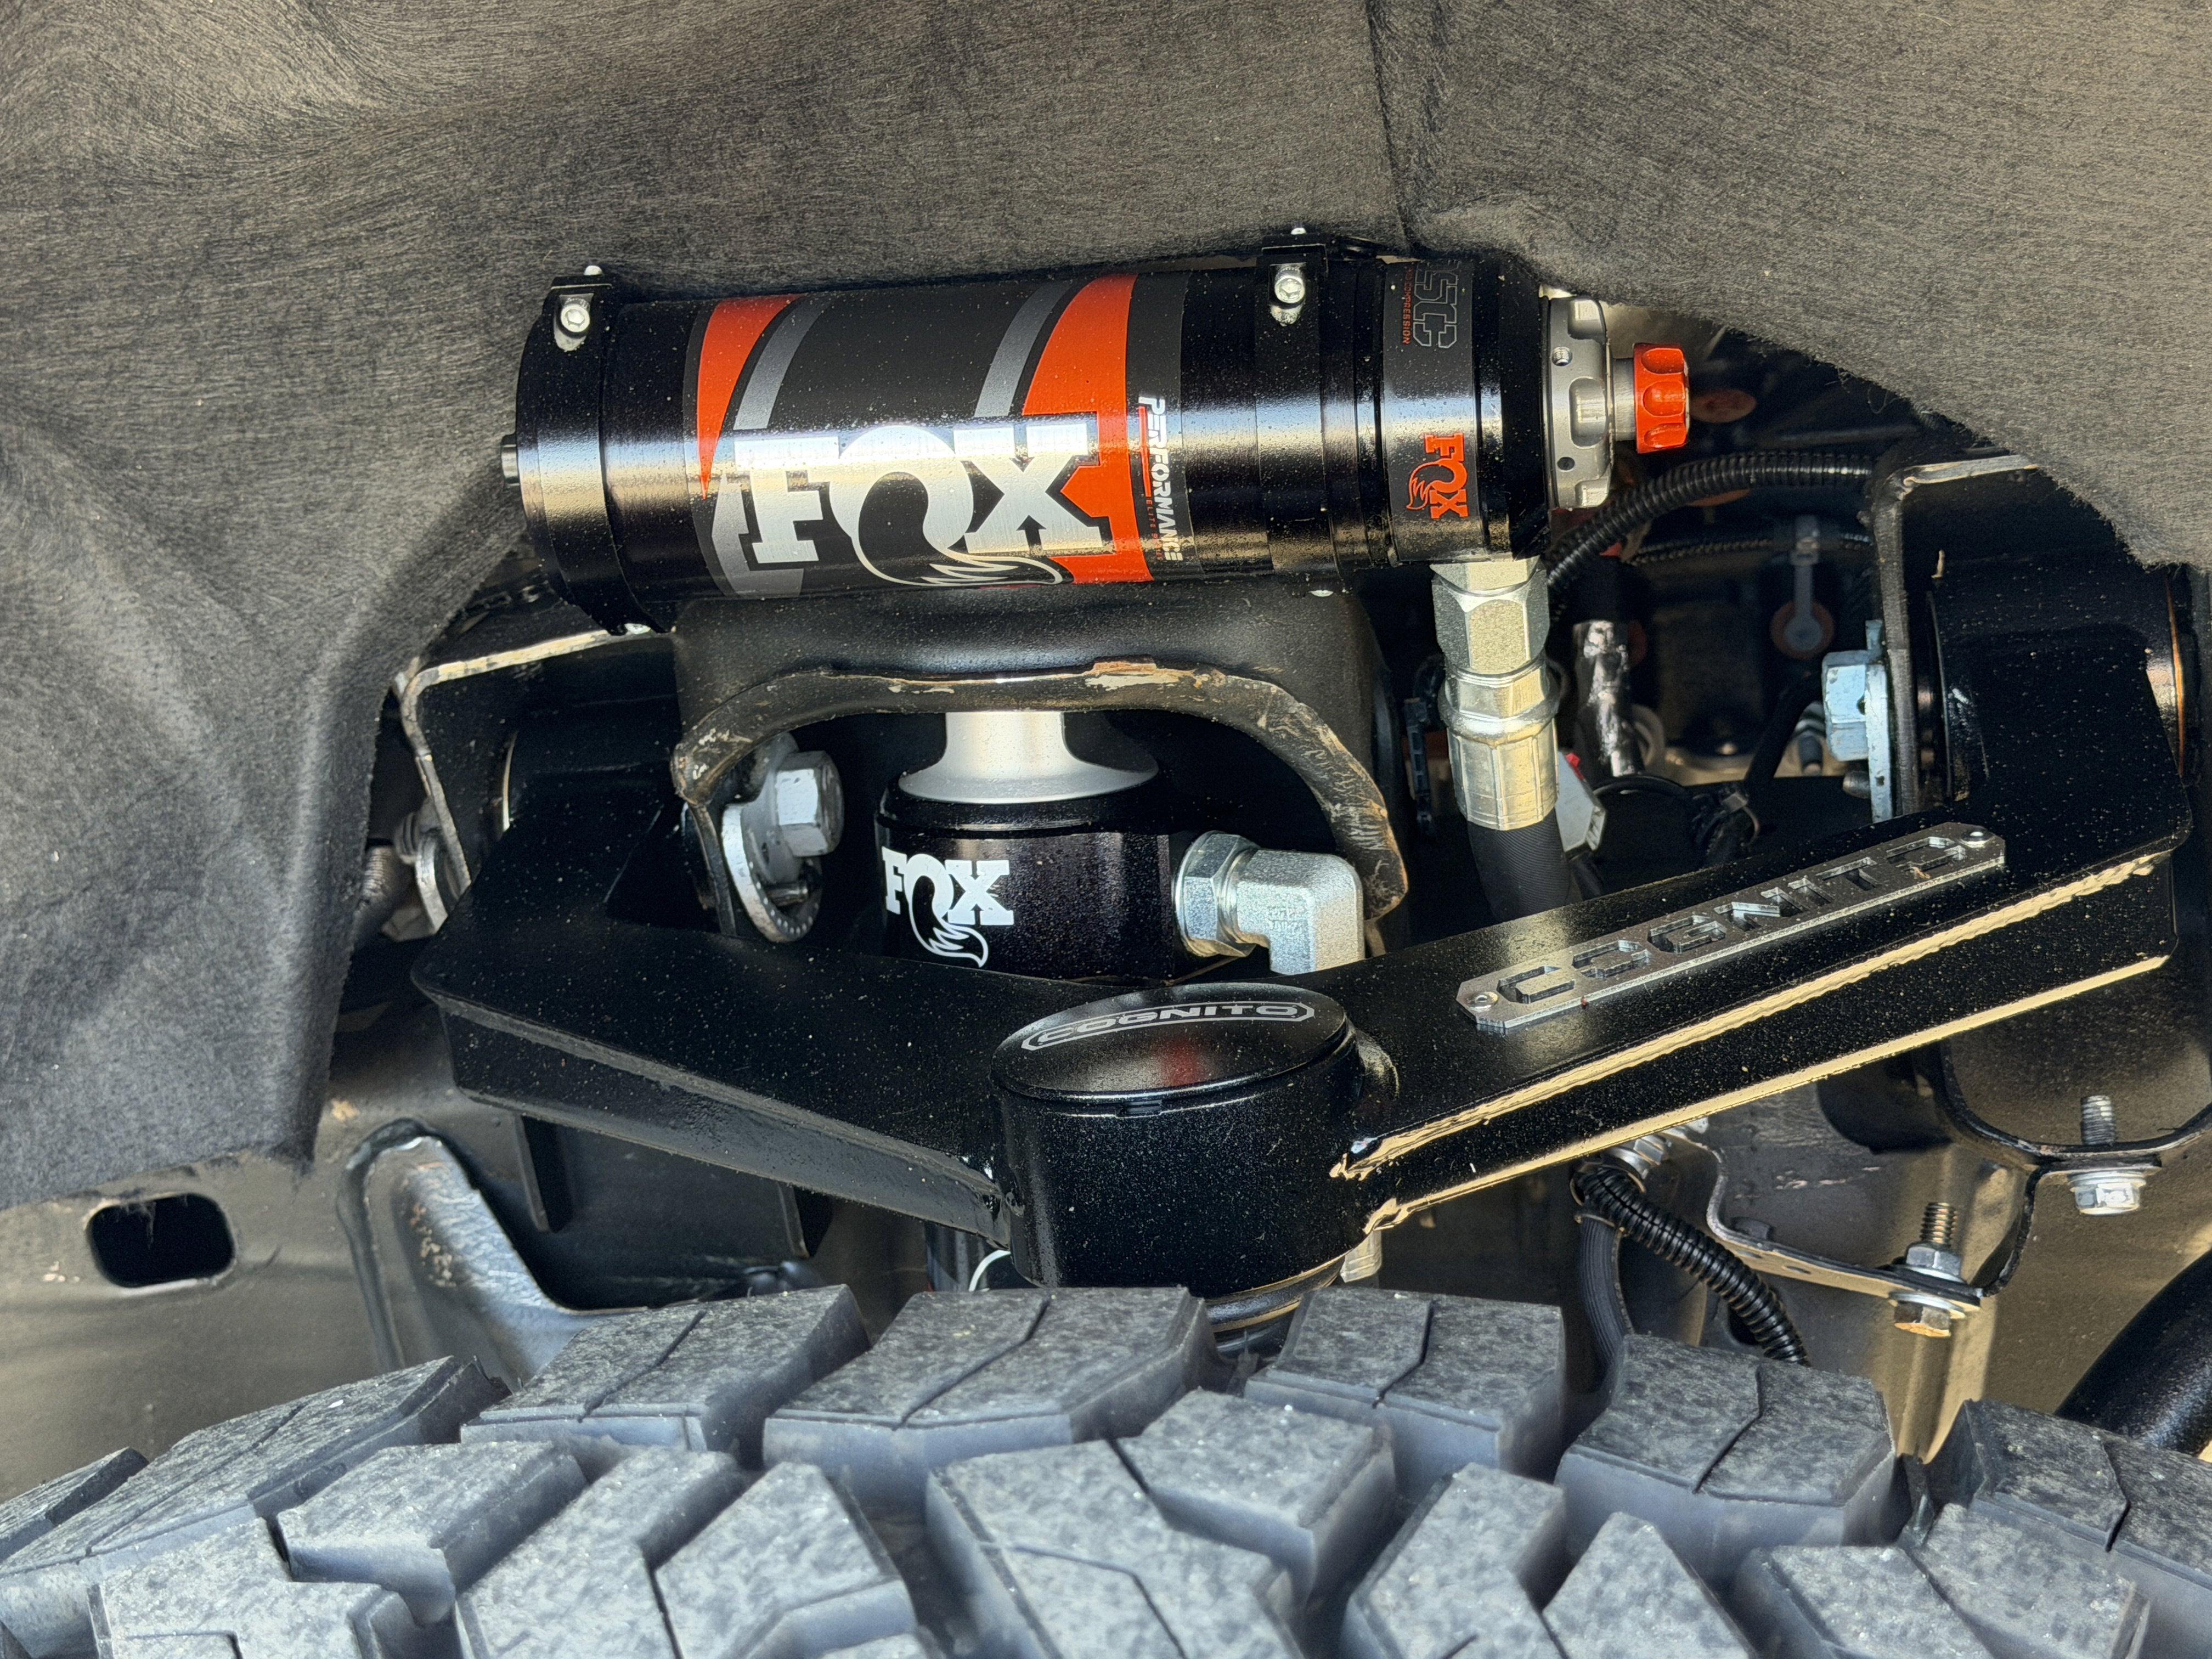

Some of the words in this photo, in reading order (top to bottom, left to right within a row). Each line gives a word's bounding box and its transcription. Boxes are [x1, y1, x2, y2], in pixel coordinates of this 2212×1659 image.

[1413, 261, 1457, 349] SC
[734, 425, 1104, 587] FOX
[1138, 395, 1183, 562] PERFORMANCE
[1406, 432, 1469, 519] FOX
[881, 845, 1014, 968] FOX
[1496, 835, 1966, 1005] COGNITO
[1037, 1004, 1299, 1043] COGNITO
